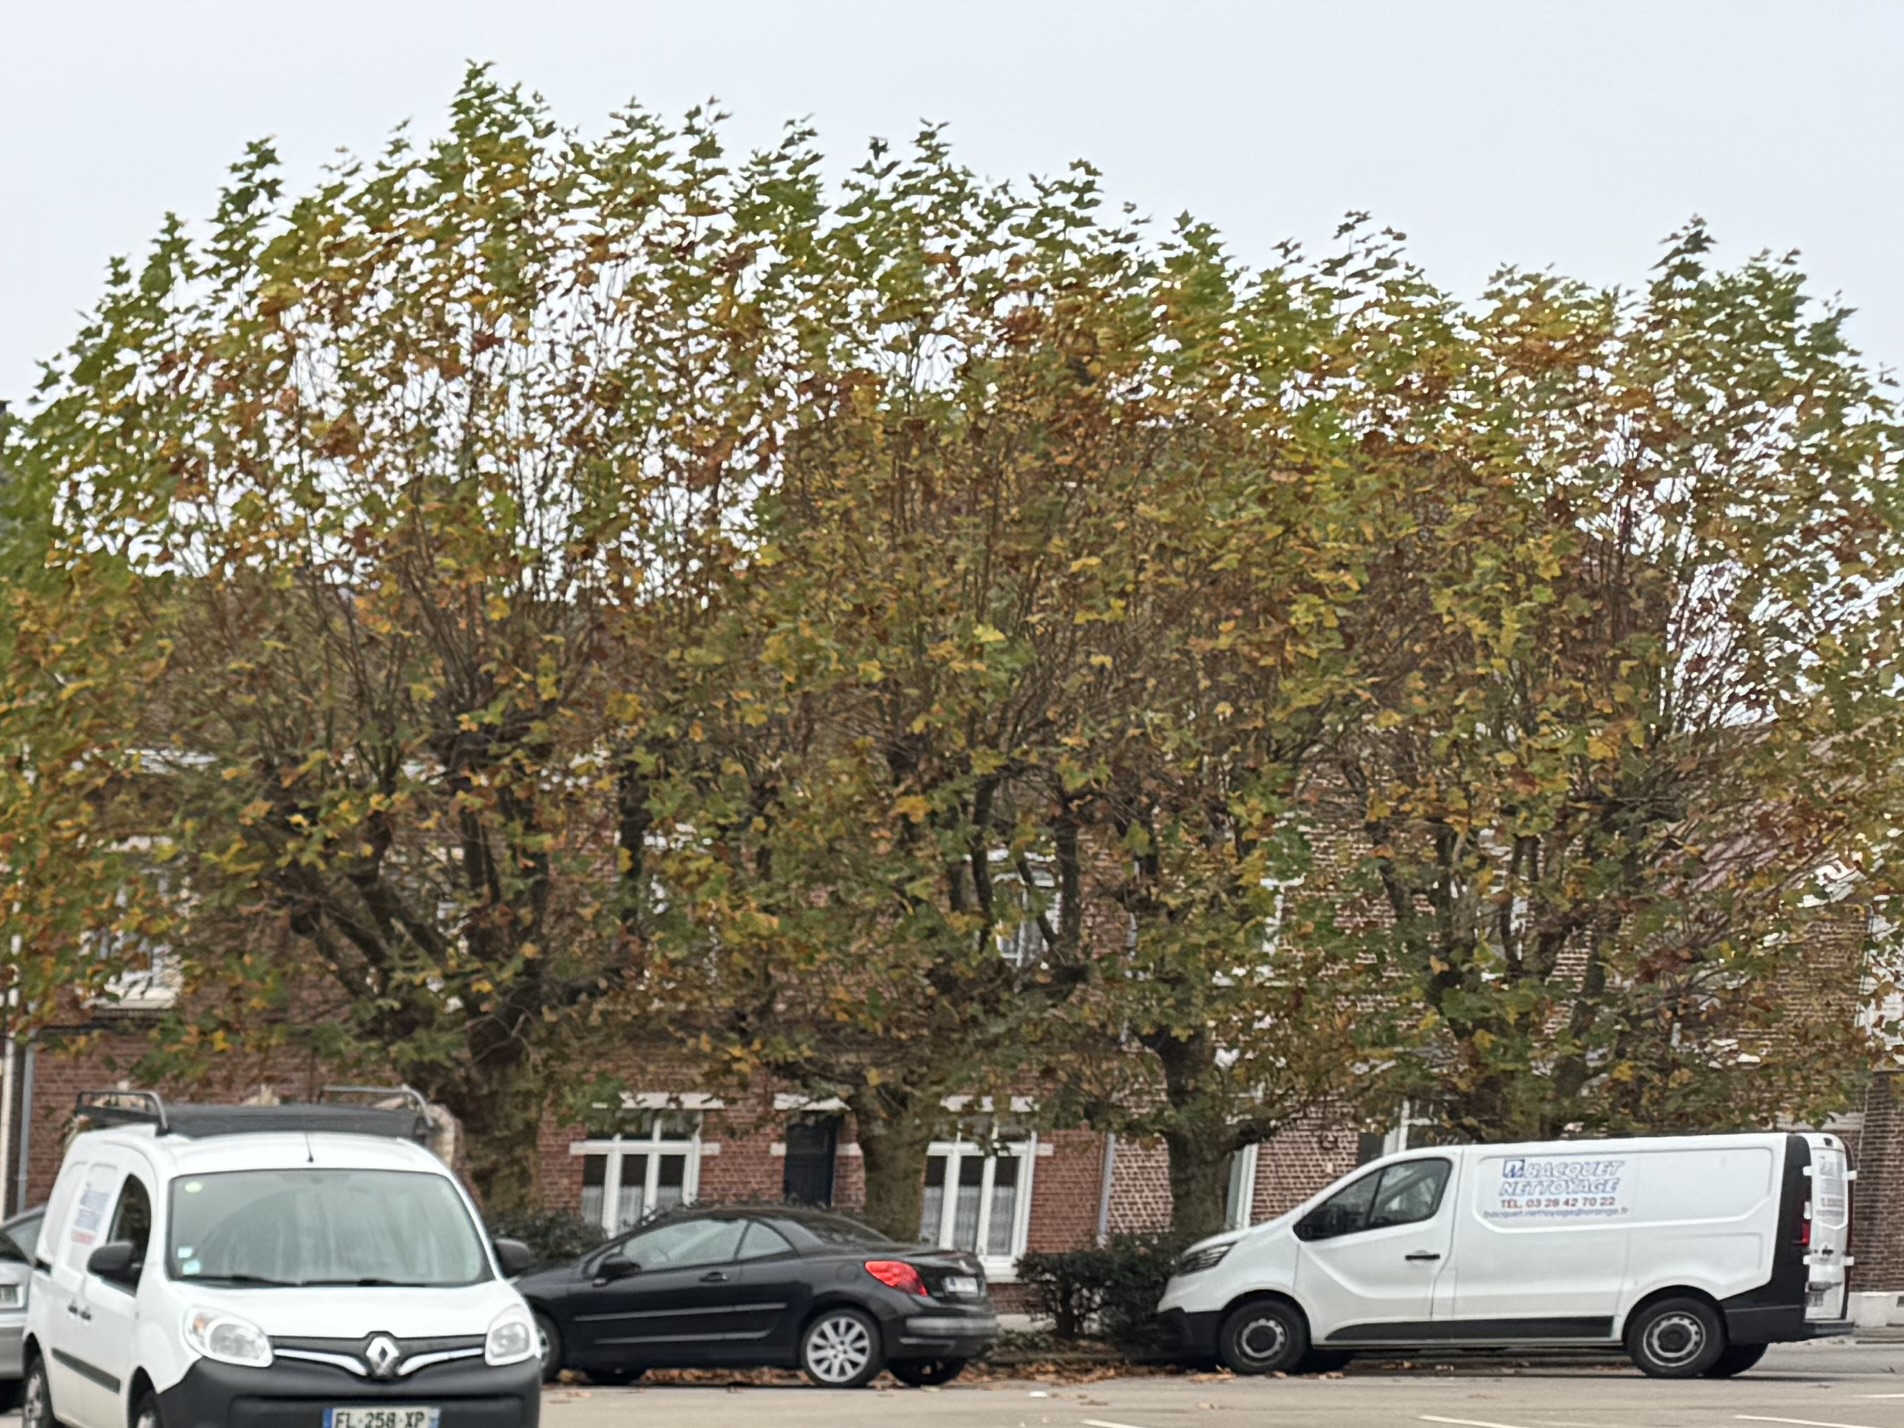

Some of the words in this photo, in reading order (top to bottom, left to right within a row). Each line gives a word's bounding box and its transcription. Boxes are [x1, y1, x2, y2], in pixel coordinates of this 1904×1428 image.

[1525, 1160, 1625, 1179] BACQUET
[1498, 1177, 1622, 1197] NETTOYAGE
[1526, 1199, 1542, 1208] 03
[1600, 1197, 1617, 1207] 22
